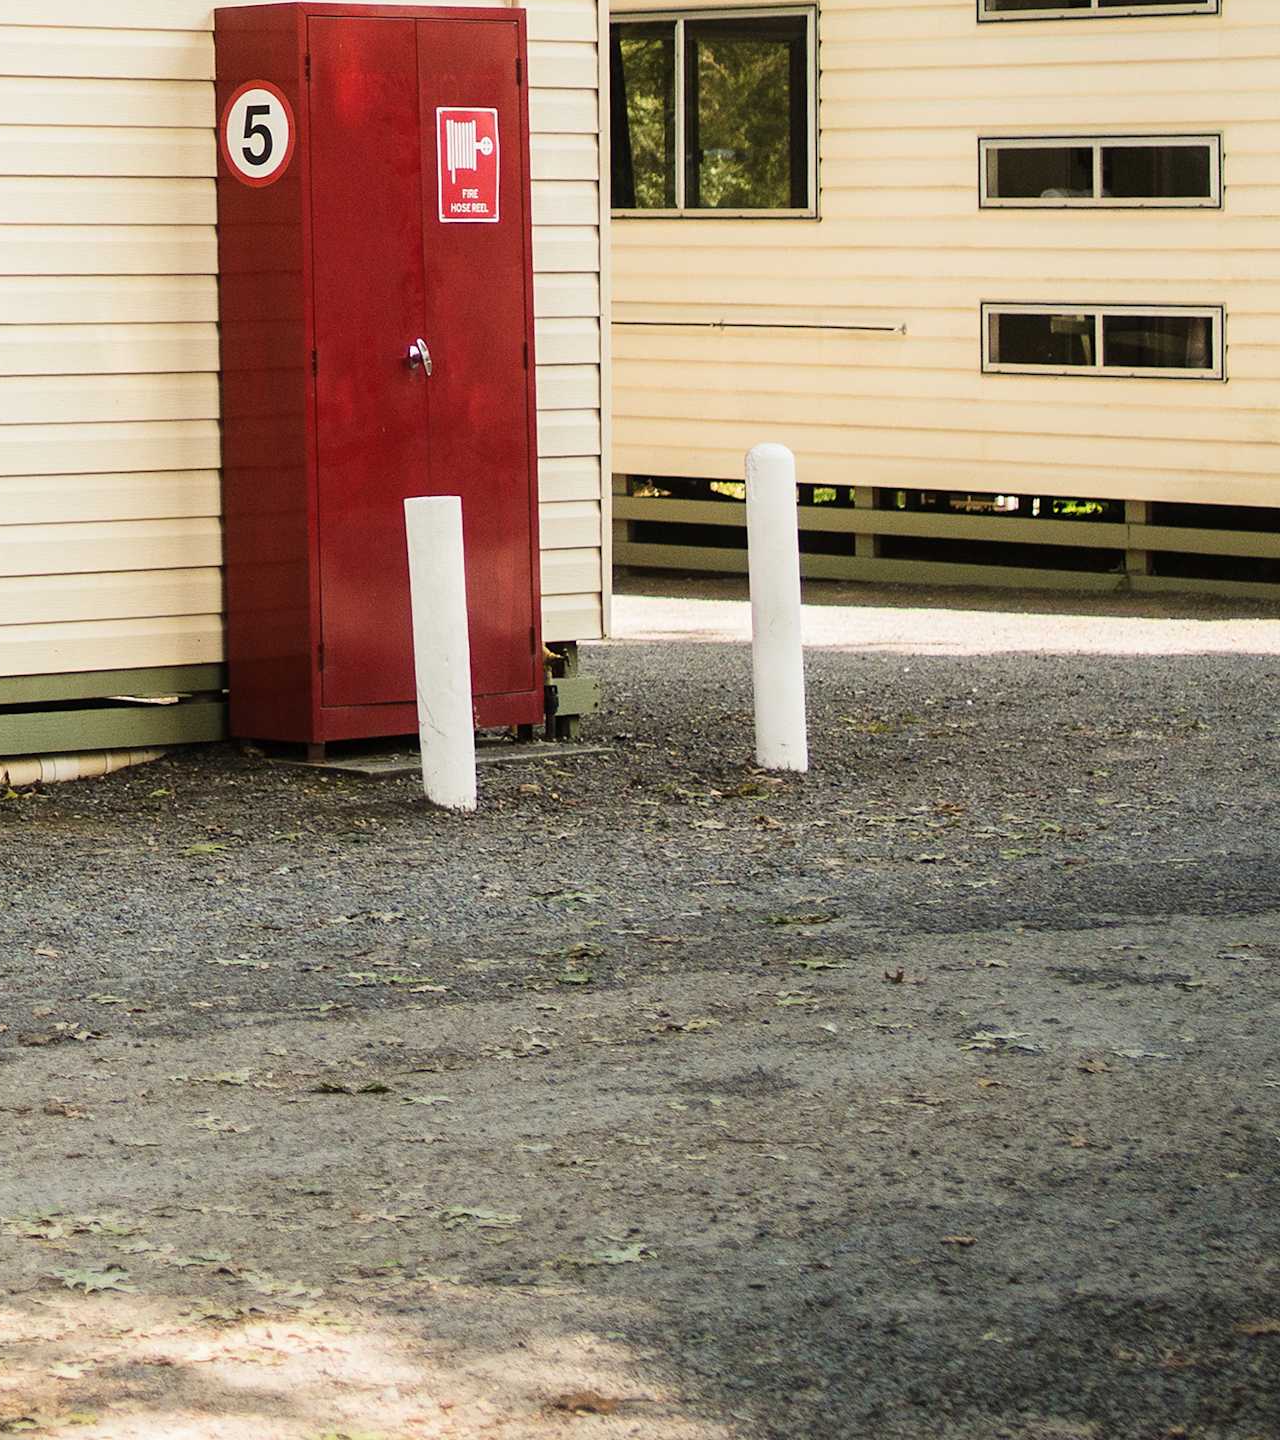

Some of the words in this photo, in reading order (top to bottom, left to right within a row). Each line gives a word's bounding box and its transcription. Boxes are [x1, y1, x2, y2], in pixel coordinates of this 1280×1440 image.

[242, 105, 273, 166] 5
[462, 188, 479, 199] FIRE
[450, 202, 471, 213] HOSE
[471, 202, 489, 213] REEL
